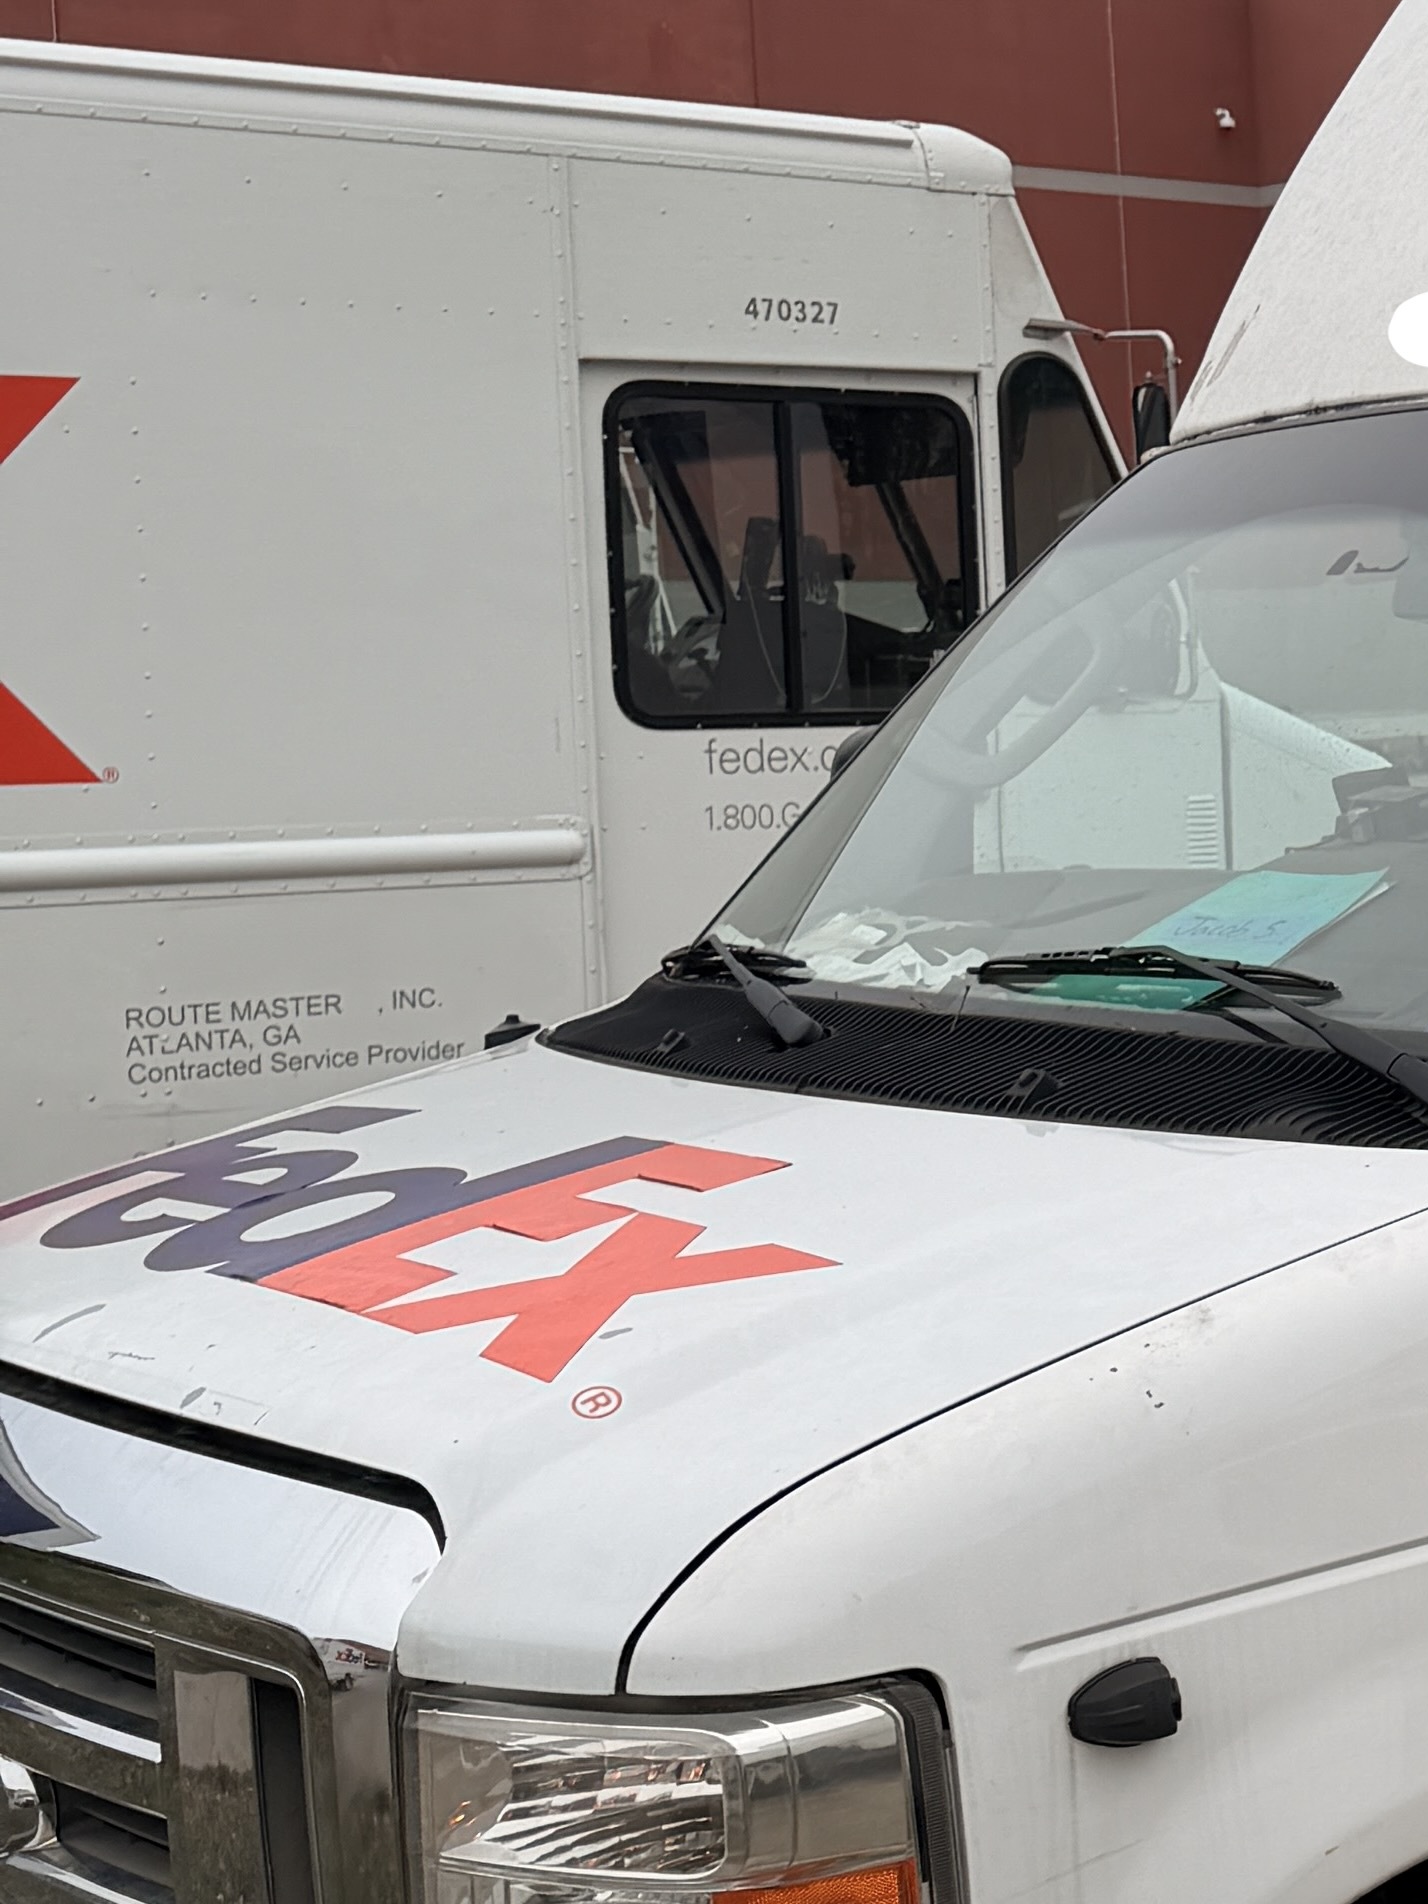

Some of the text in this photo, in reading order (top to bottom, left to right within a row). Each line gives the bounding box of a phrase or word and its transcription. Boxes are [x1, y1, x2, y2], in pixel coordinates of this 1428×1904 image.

[744, 296, 839, 326] 470327
[125, 1001, 222, 1030] ROUTE
[230, 993, 342, 1023] MASTER
[391, 987, 443, 1011] INC.
[125, 1023, 302, 1058] ATLANTA, GA
[127, 1039, 466, 1085] Contracted Service Provider
[0, 1105, 843, 1383] FedEx
